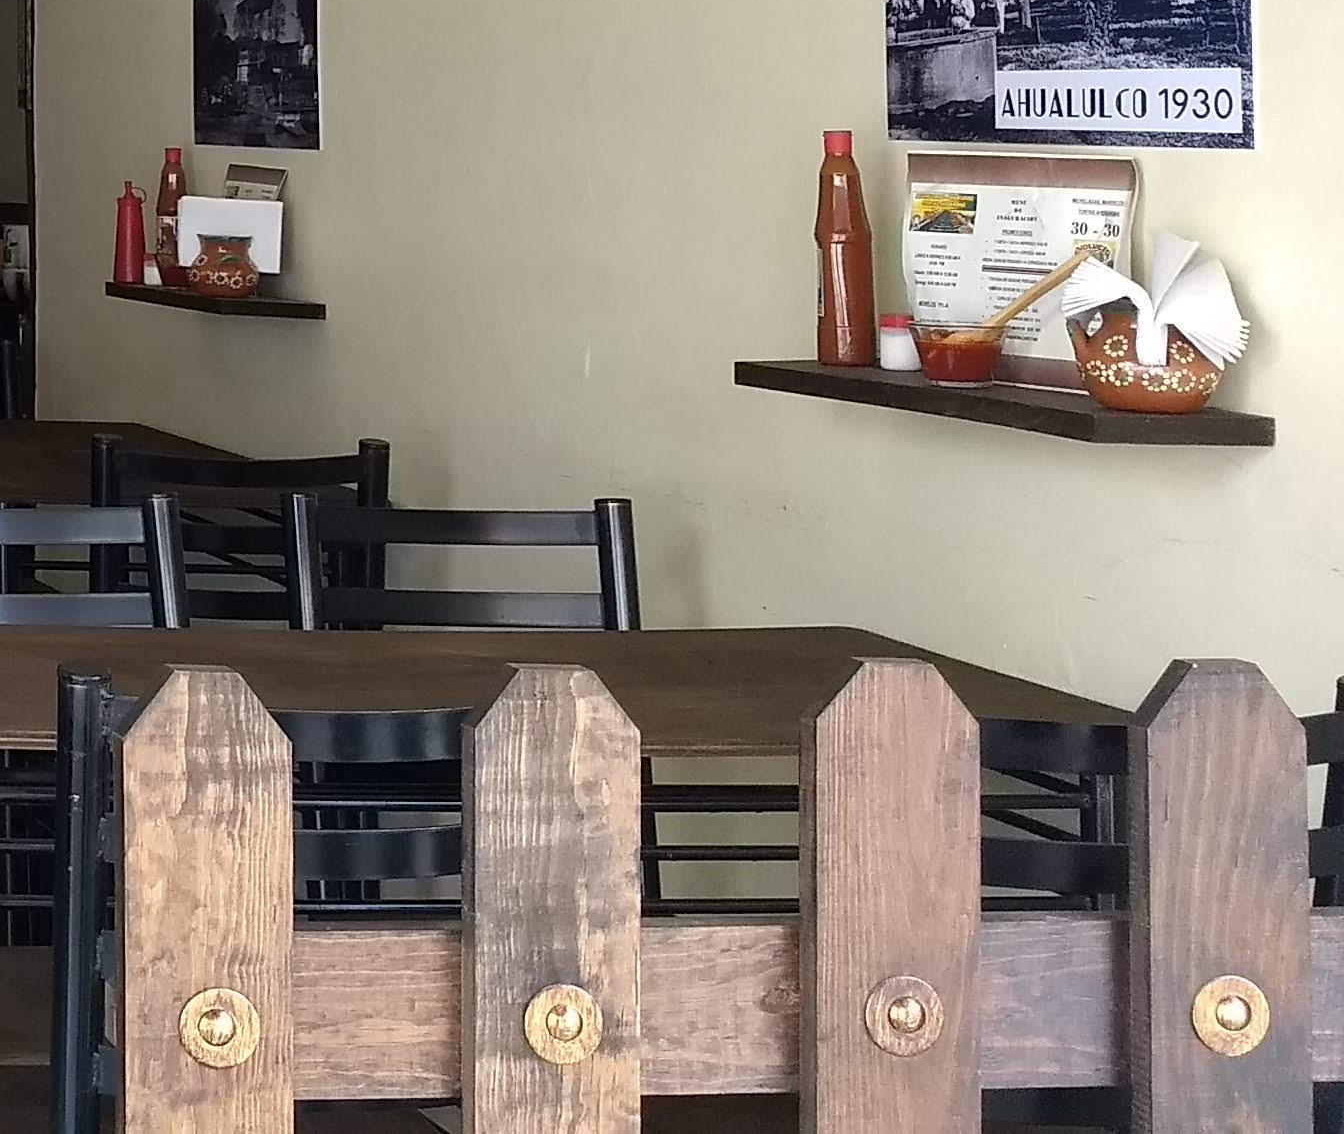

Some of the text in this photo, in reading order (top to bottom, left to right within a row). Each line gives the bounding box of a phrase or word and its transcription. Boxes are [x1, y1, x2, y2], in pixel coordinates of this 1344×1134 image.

[1001, 88, 1234, 120] AHUALULCO 1930
[1070, 221, 1088, 236] 30
[1103, 223, 1120, 238] 30
